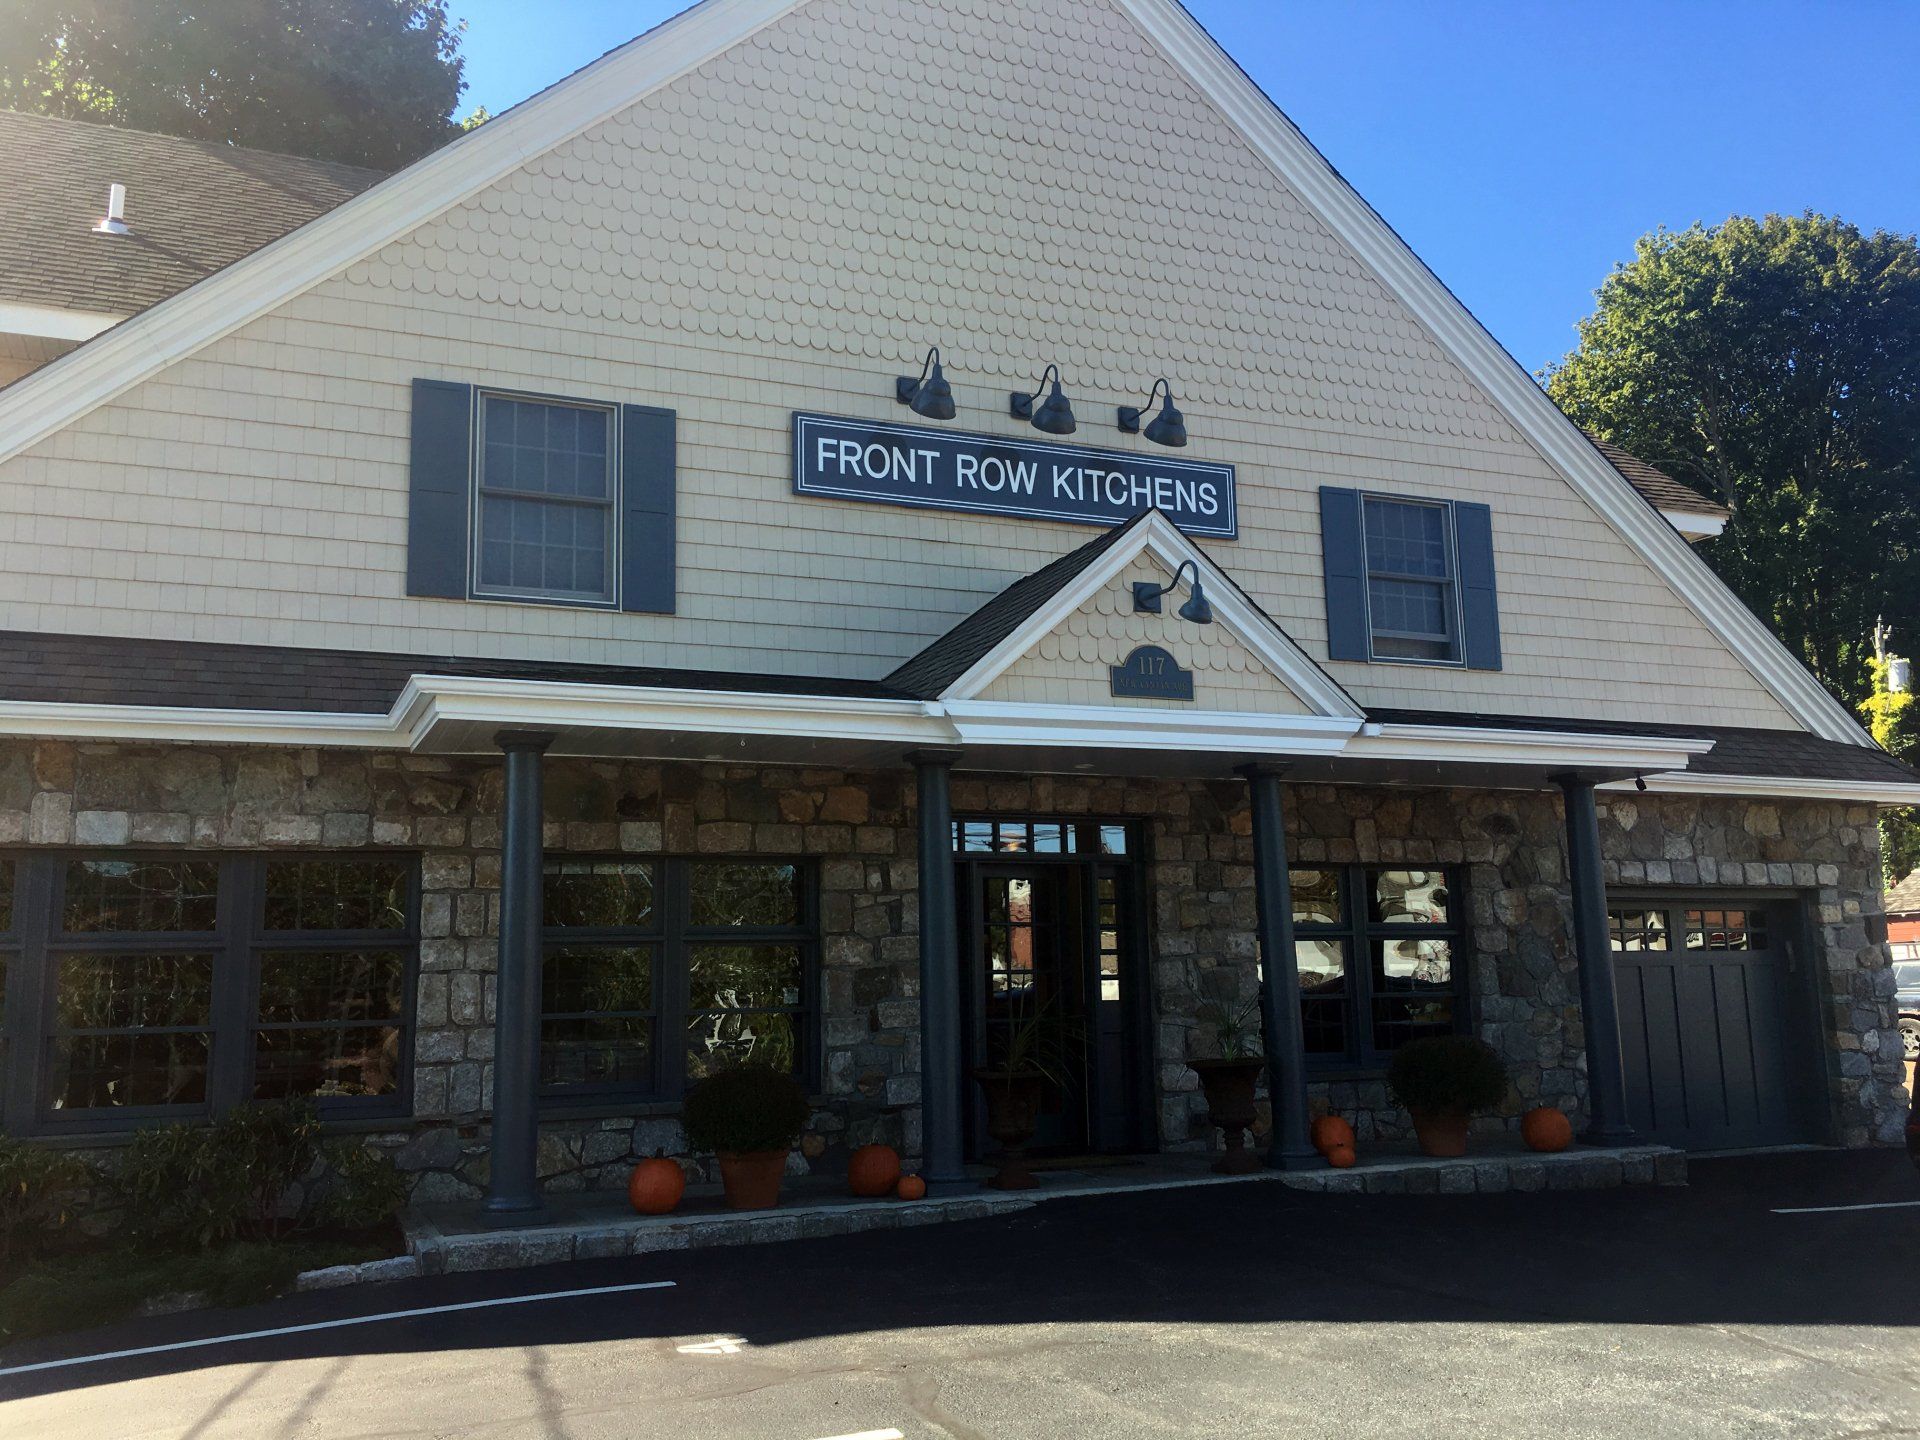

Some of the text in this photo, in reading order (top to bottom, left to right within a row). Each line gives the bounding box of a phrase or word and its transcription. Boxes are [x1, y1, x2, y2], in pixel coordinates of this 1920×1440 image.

[817, 437, 1218, 515] FRONT ROW KITCHENS
[1139, 656, 1165, 675] 117
